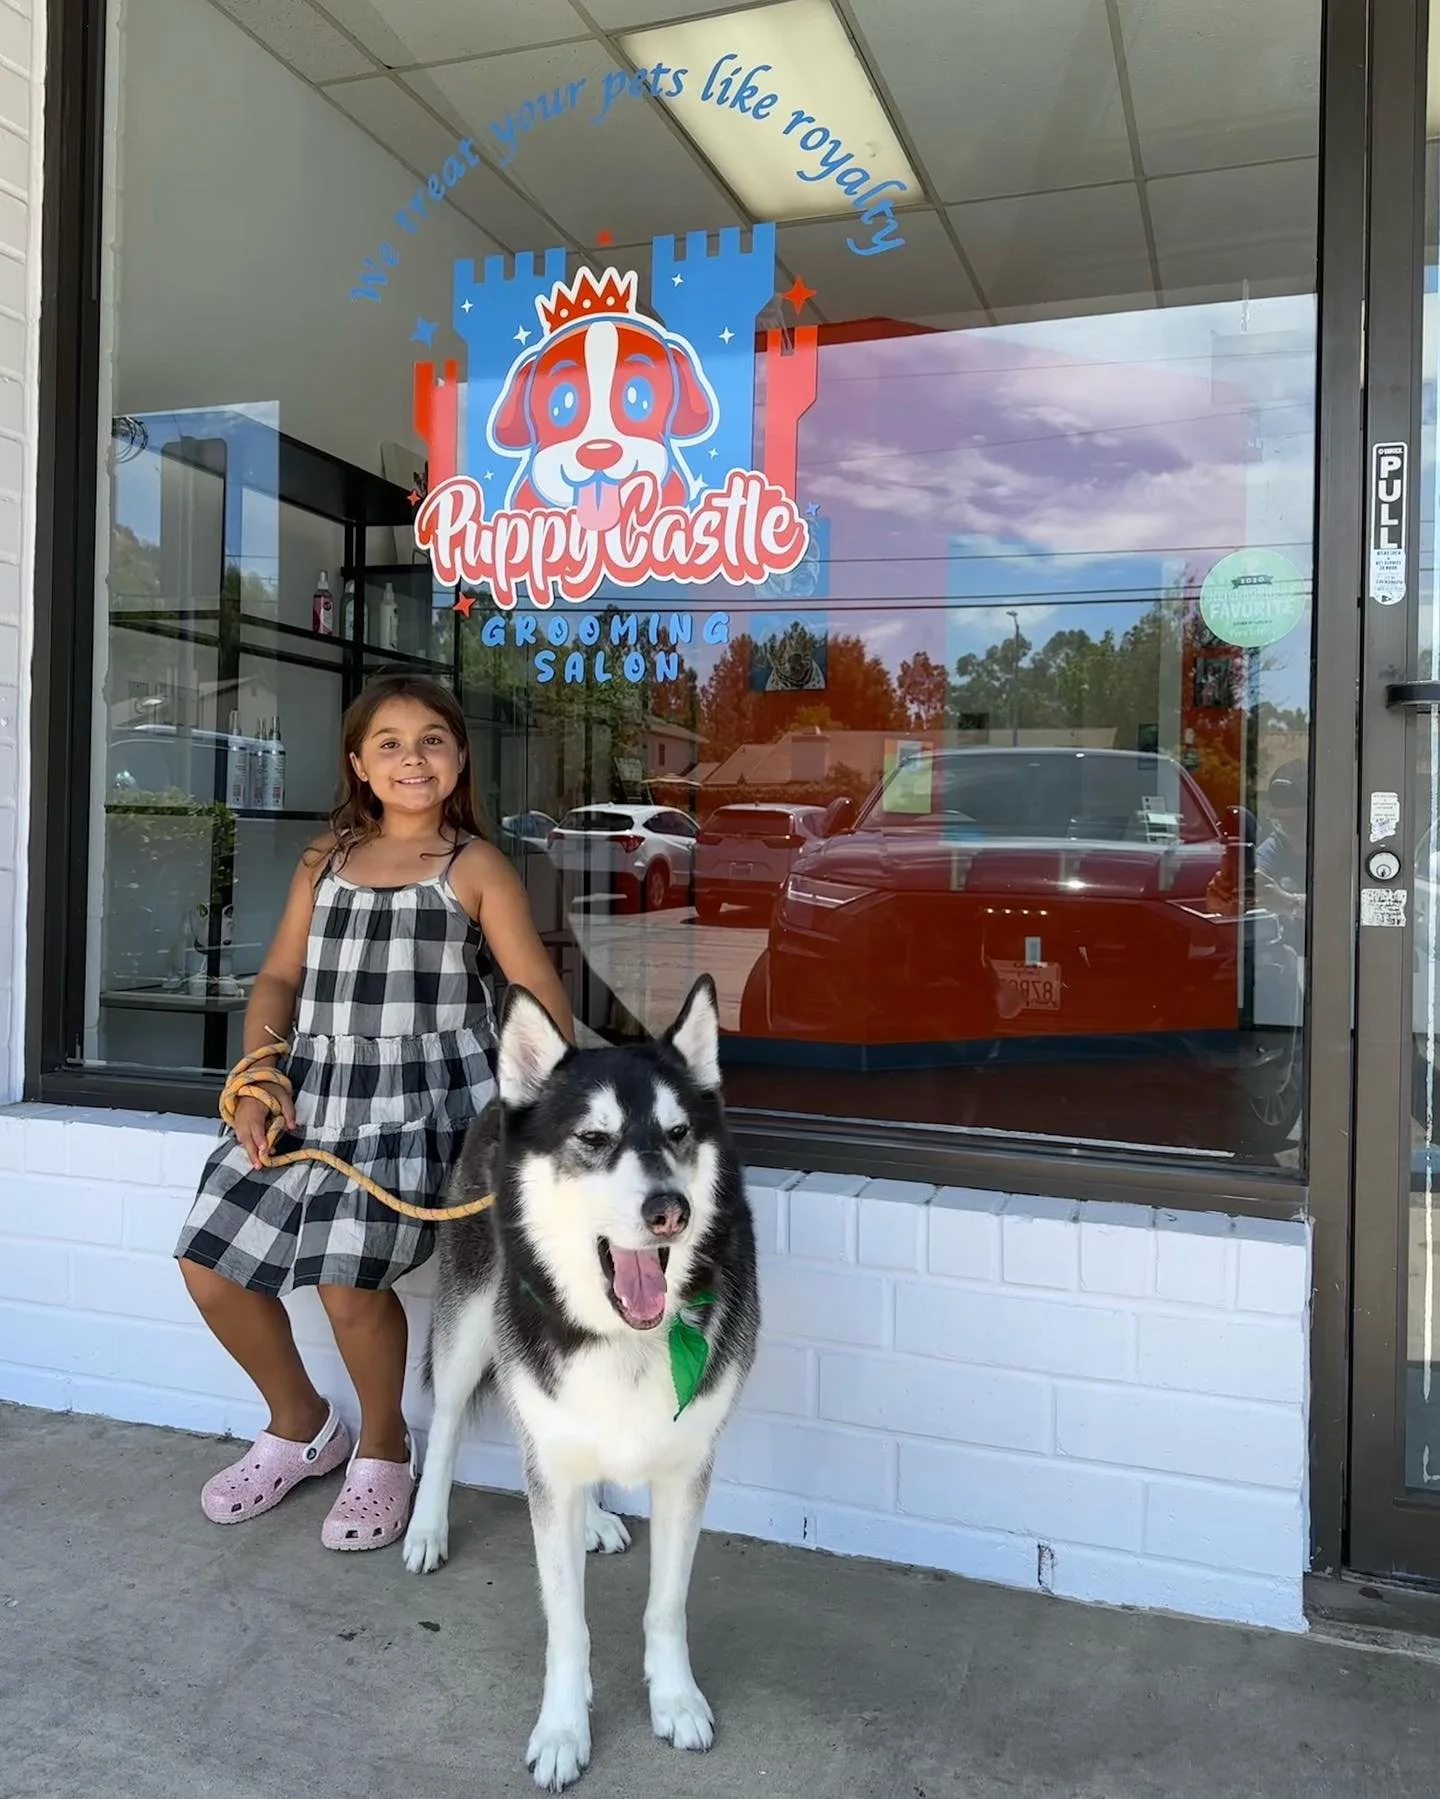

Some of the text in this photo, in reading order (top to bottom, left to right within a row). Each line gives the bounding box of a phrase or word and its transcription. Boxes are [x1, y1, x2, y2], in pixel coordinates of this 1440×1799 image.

[350, 53, 908, 304] We treat your pets like royalty
[1377, 455, 1403, 550] PULL
[415, 469, 809, 609] Puppy Castle
[480, 611, 731, 648] GROOMING
[1209, 597, 1296, 621] FAVORITE
[533, 651, 680, 685] SALON
